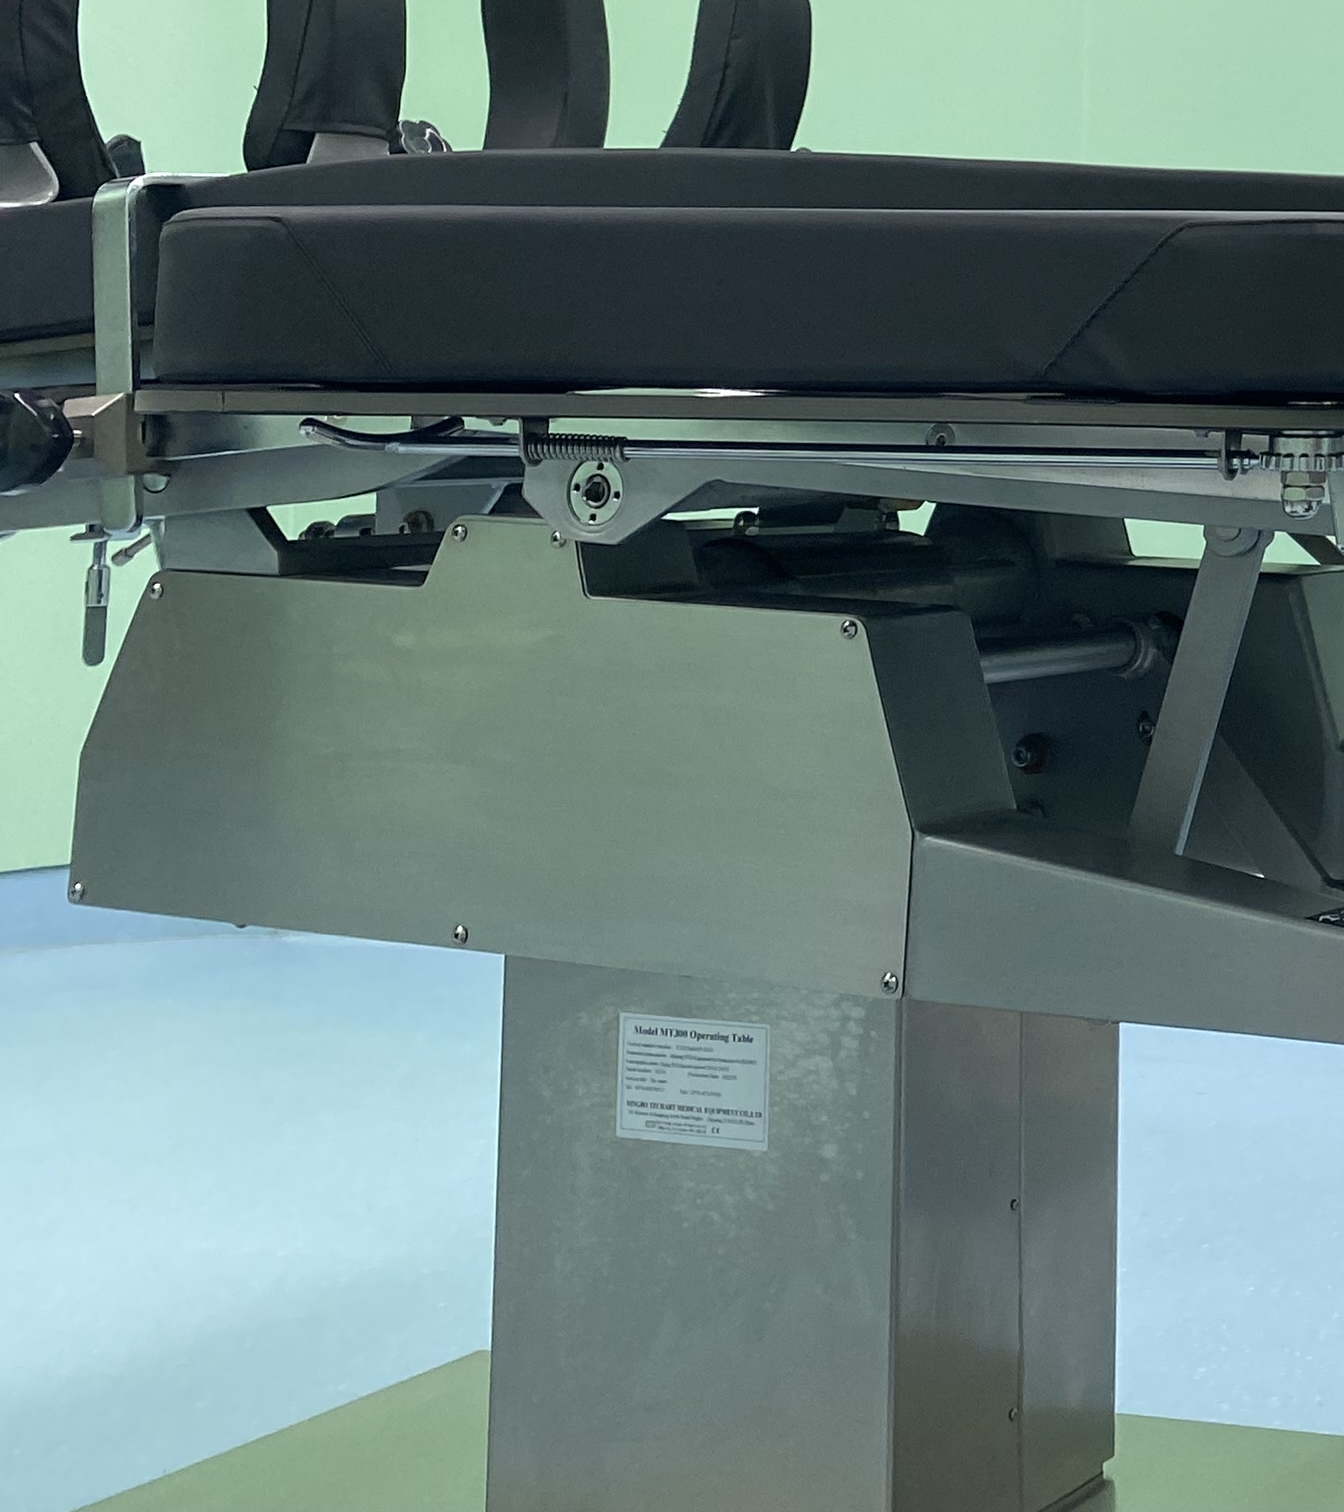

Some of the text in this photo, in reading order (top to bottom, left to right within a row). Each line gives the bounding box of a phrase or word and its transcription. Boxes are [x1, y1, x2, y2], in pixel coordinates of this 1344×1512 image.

[634, 1025, 658, 1036] Model
[689, 1029, 729, 1044] Operating
[731, 1033, 754, 1044] Table
[677, 1103, 703, 1113] MEDICAL
[704, 1106, 739, 1117] EQUIPMENT
